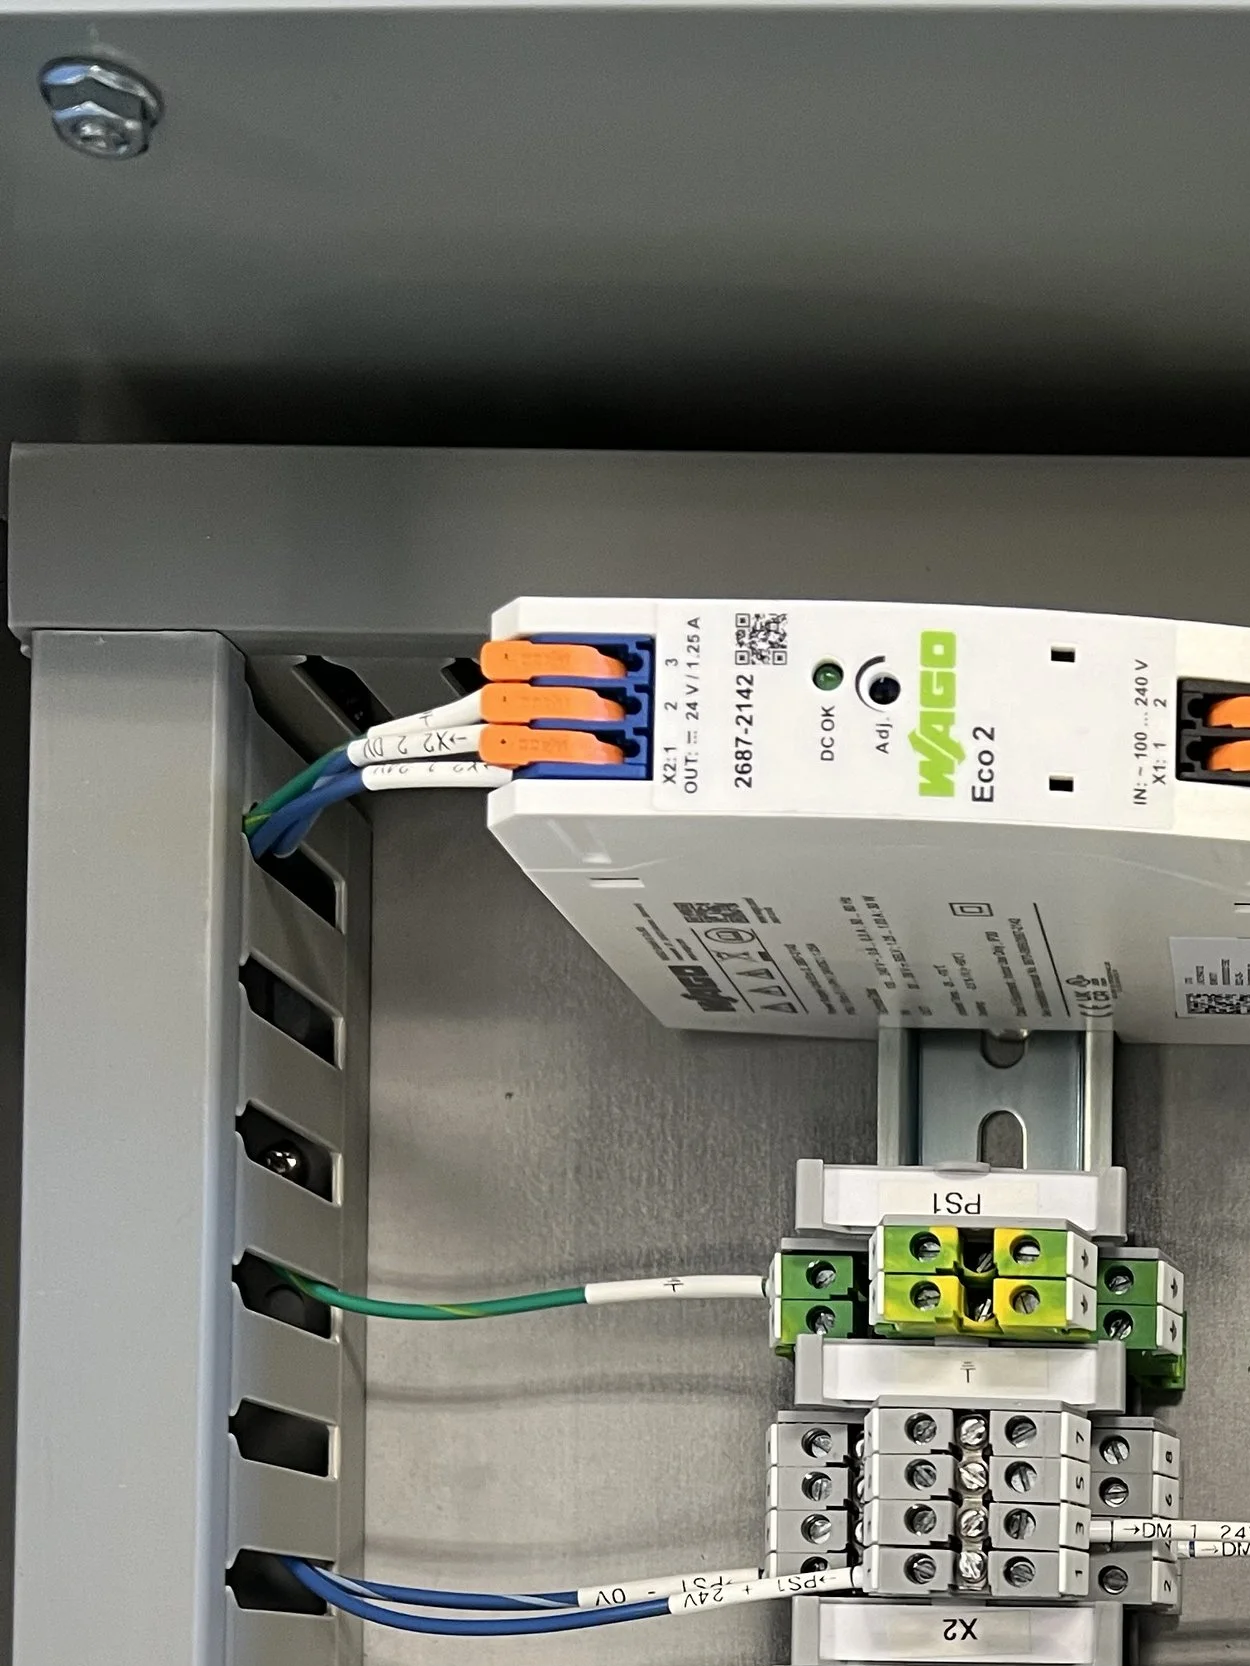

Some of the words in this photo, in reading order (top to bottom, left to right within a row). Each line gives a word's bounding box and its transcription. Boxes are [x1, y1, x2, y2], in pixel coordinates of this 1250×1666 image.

[687, 616, 701, 629] A
[665, 657, 679, 667] 3
[686, 634, 700, 669] 1.25
[1134, 659, 1149, 671] V
[686, 684, 700, 695] V
[1134, 677, 1149, 707] 240
[664, 701, 678, 711] 2
[686, 701, 699, 720] 24
[908, 629, 966, 798] WAGO
[1153, 698, 1168, 708] 2
[820, 704, 836, 732] OK
[424, 731, 451, 753] X2
[734, 673, 755, 789] 2687-2142
[876, 716, 893, 754] Adj.
[974, 725, 996, 741] 2
[397, 735, 408, 755] 2
[820, 736, 836, 762] DC
[1133, 731, 1149, 759] 100
[1153, 741, 1167, 749] 1
[684, 751, 699, 794] OUT:
[972, 751, 996, 804] Eco
[1152, 759, 1167, 785] X1:
[1133, 782, 1148, 805] IN:
[932, 1191, 981, 1215] PS1
[1142, 1522, 1173, 1538] DM
[1189, 1524, 1197, 1539] 1
[777, 1577, 818, 1594] PS1
[596, 1587, 626, 1607] 0V
[683, 1587, 725, 1609] 24V
[943, 1616, 978, 1641] X2
